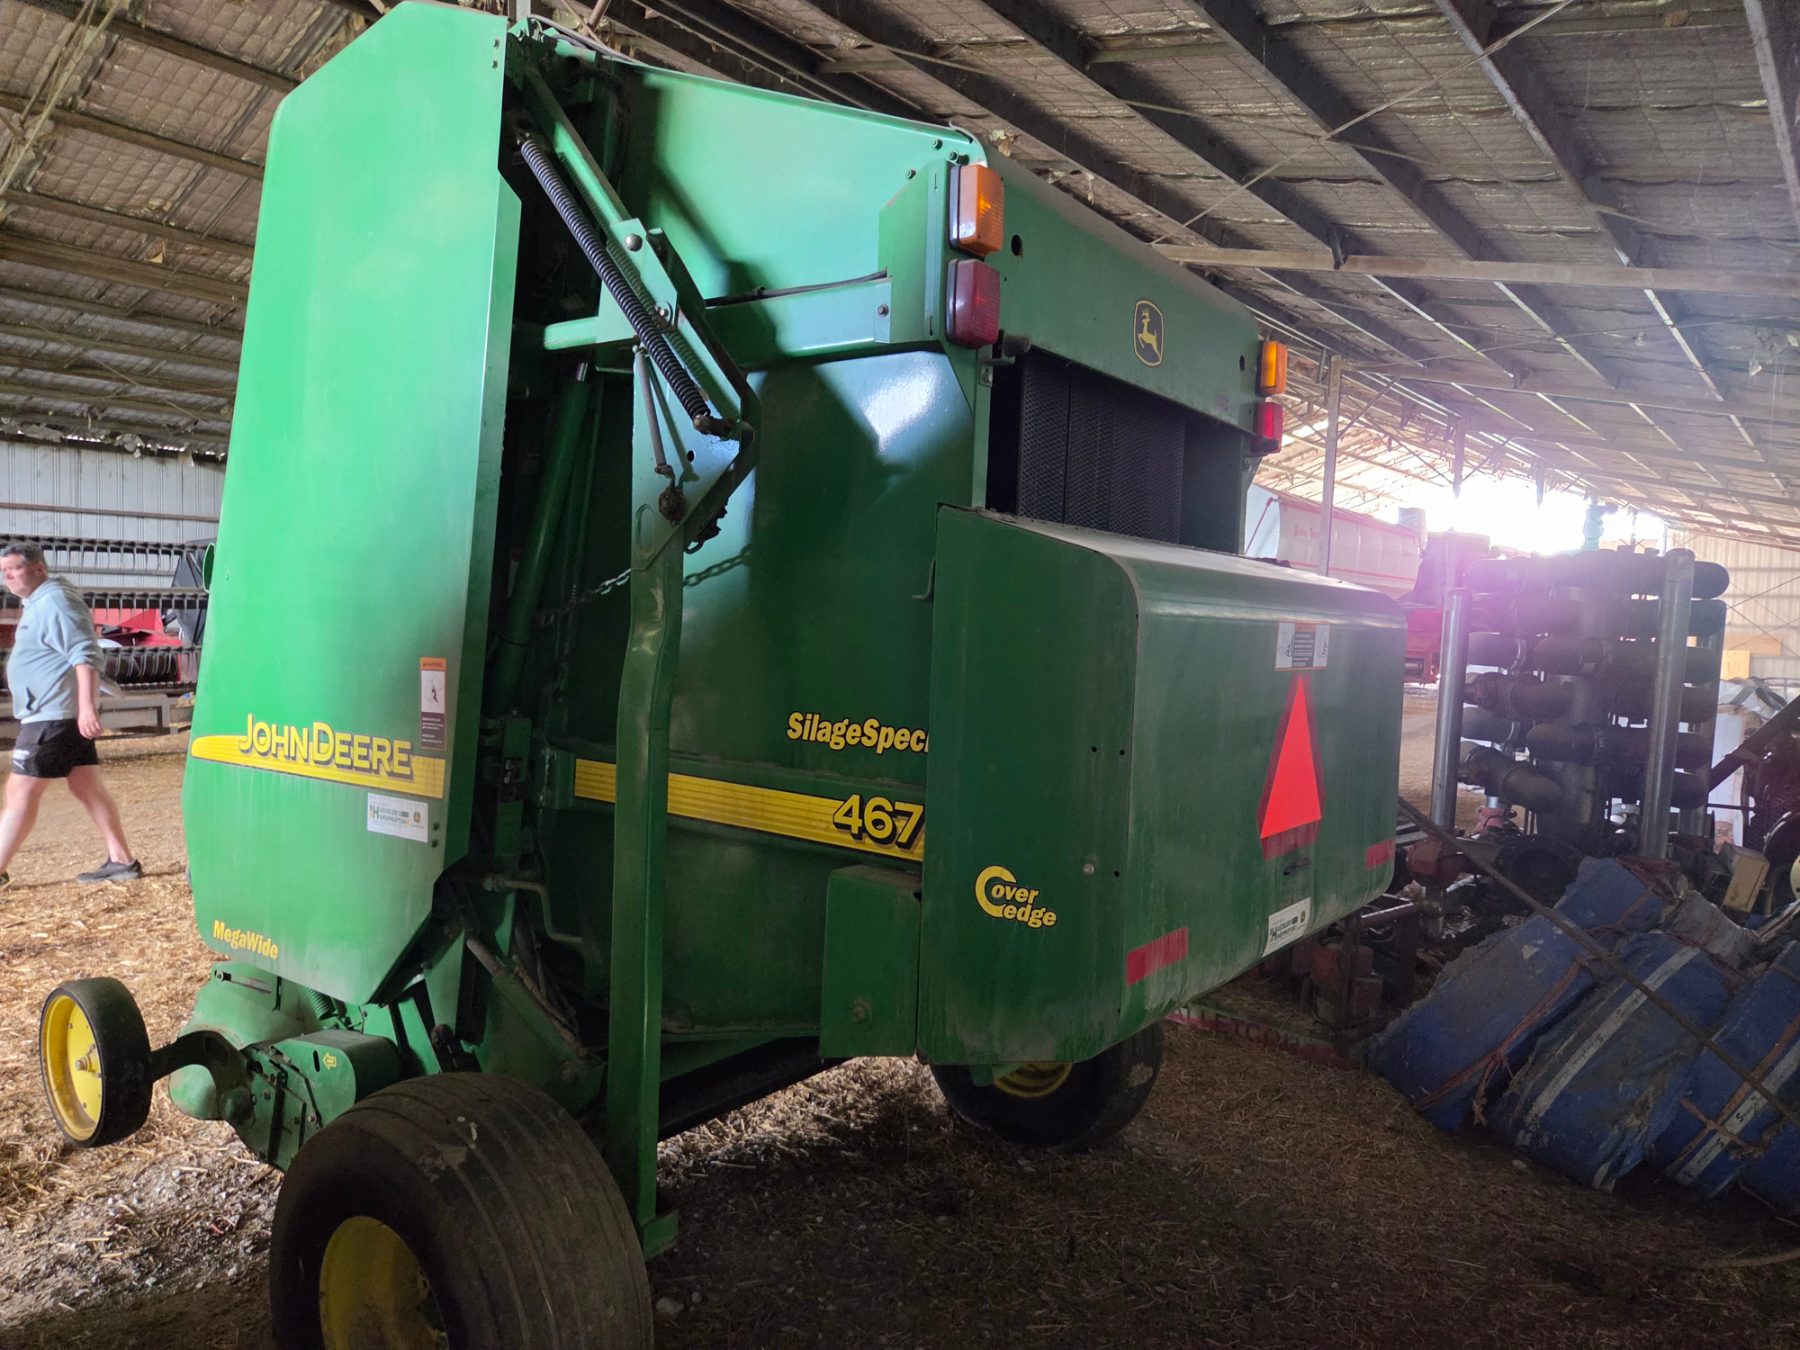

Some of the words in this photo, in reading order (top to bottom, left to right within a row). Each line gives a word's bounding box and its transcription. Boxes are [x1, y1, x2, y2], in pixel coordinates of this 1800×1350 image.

[833, 794, 924, 850] 467
[975, 865, 1040, 918] Cover
[213, 919, 279, 959] MegaWide
[1003, 904, 1057, 928] edge
